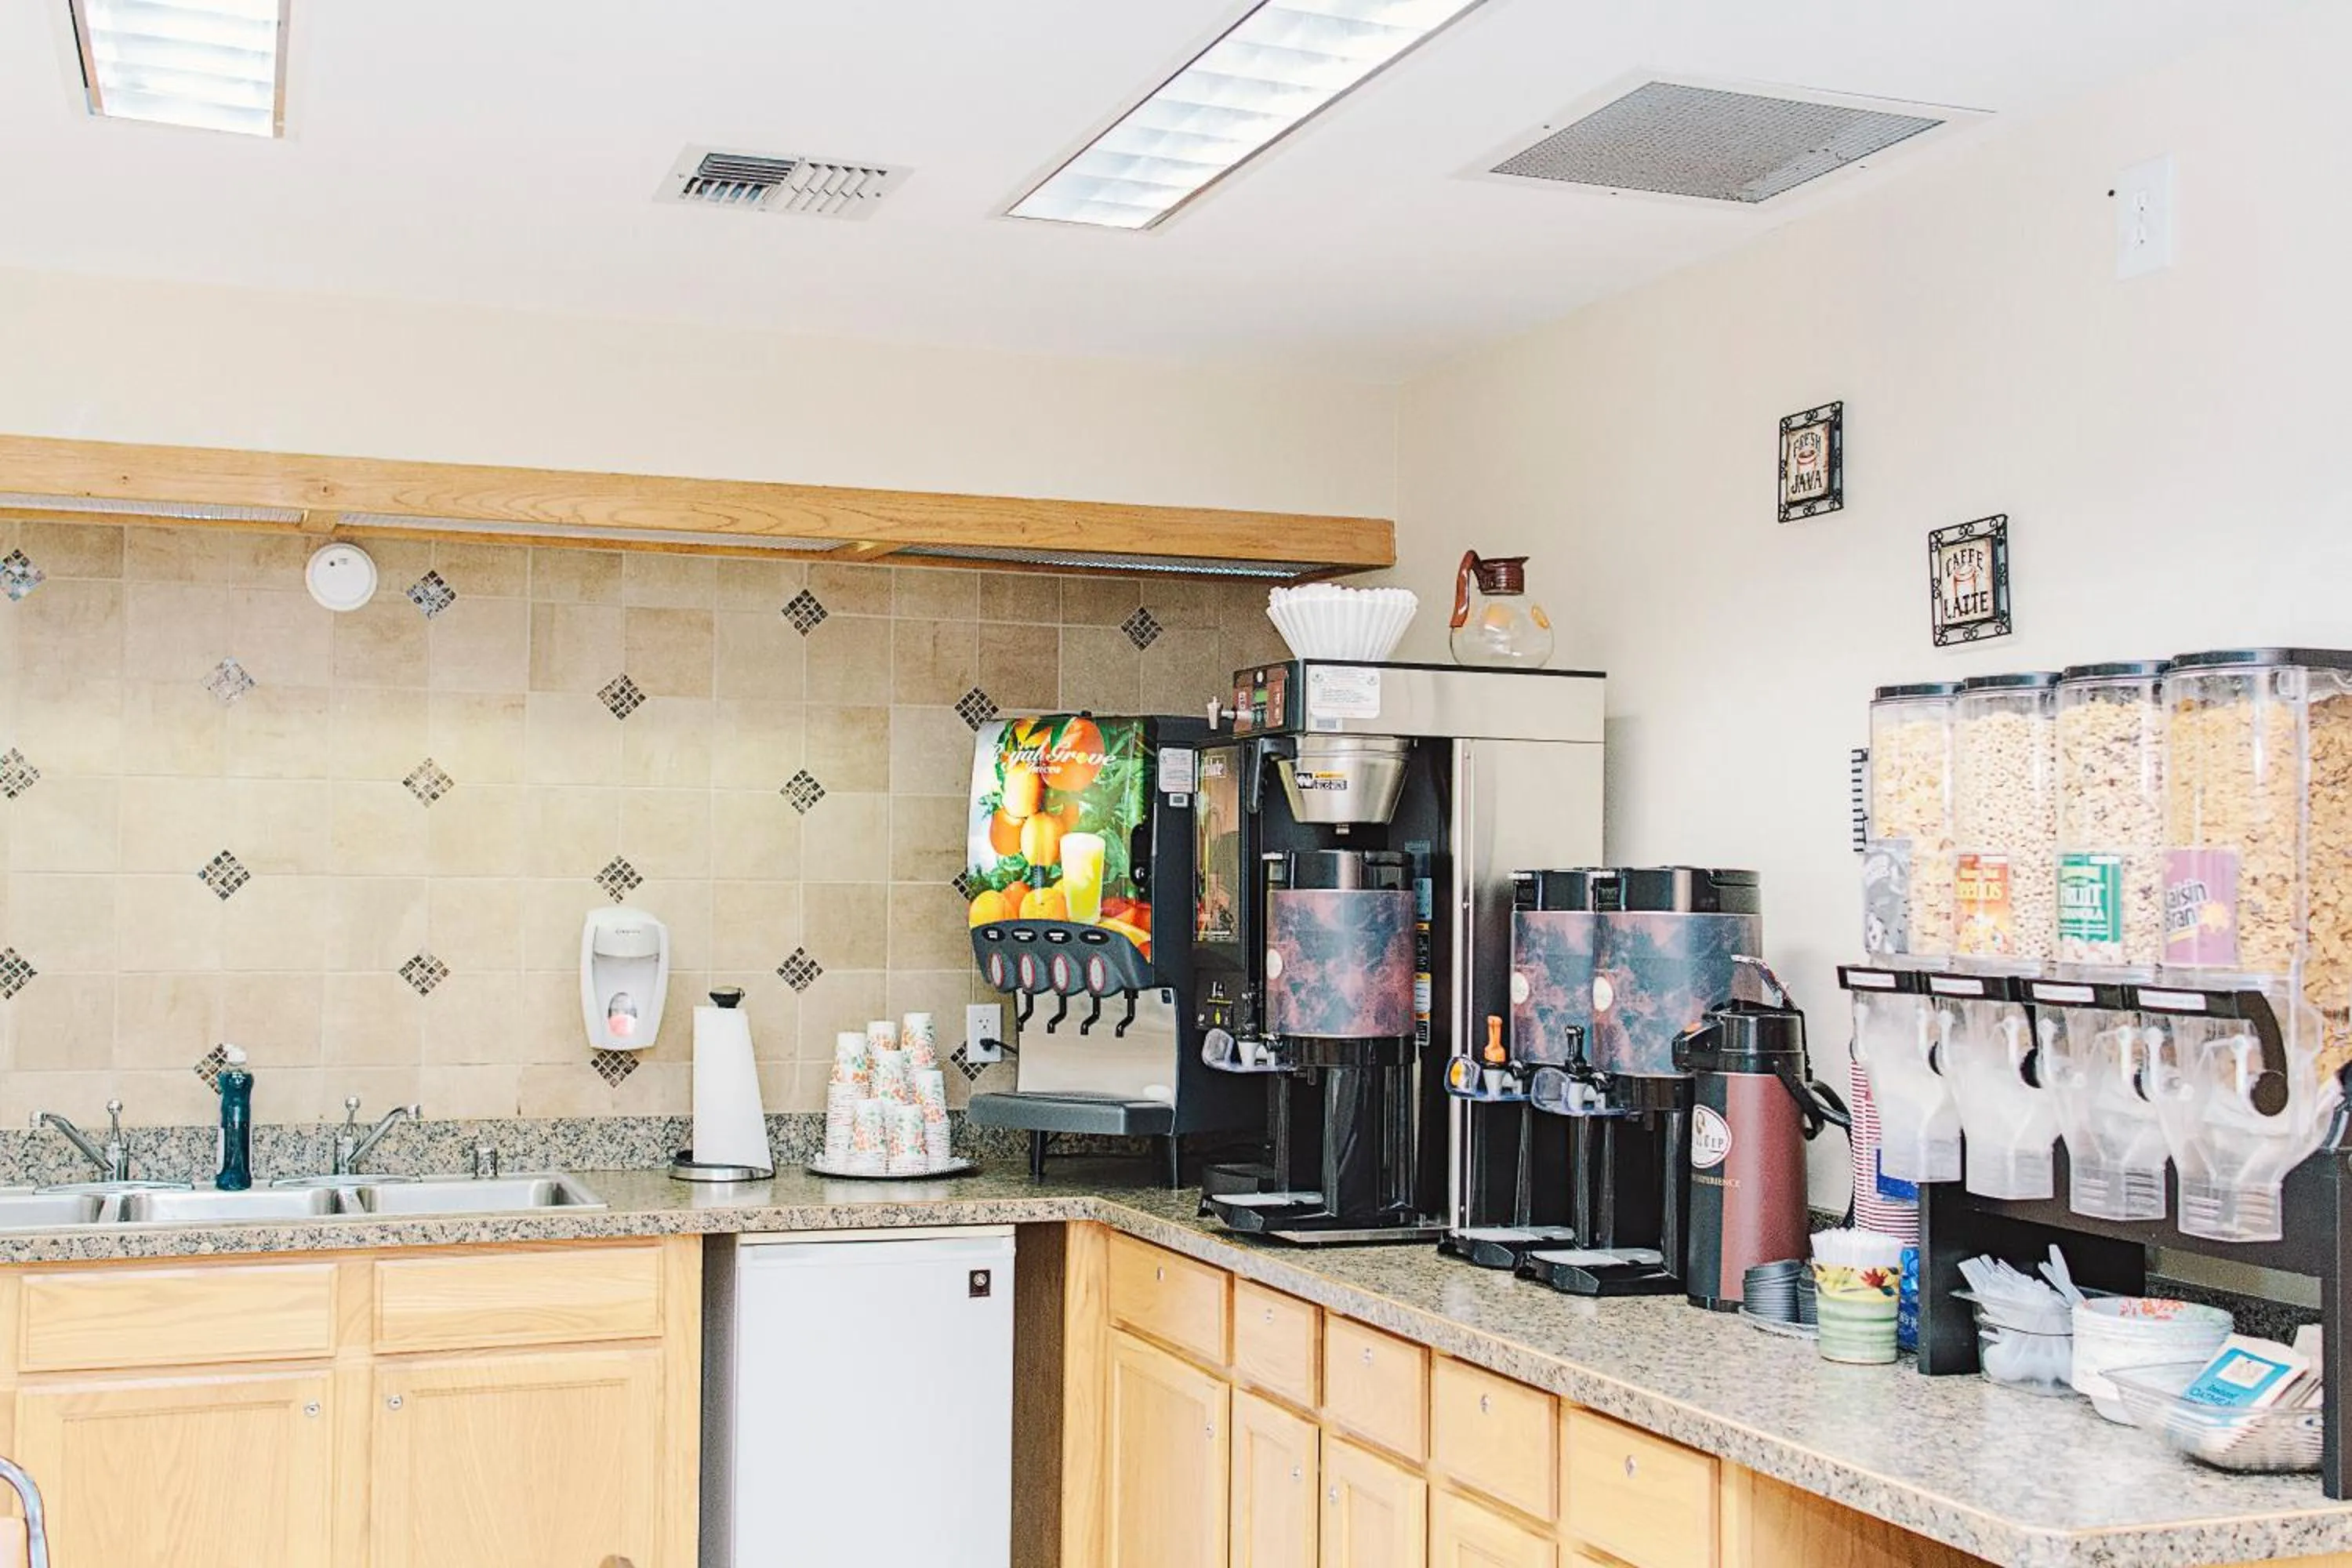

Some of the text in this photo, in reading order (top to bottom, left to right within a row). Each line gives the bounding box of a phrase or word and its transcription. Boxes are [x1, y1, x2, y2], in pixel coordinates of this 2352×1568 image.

[1793, 432, 1821, 459] FRESH
[1790, 470, 1823, 495] JAVA
[1945, 548, 1984, 578] CAFFE
[1944, 590, 1989, 619] LATTE
[2165, 878, 2207, 908] aisin
